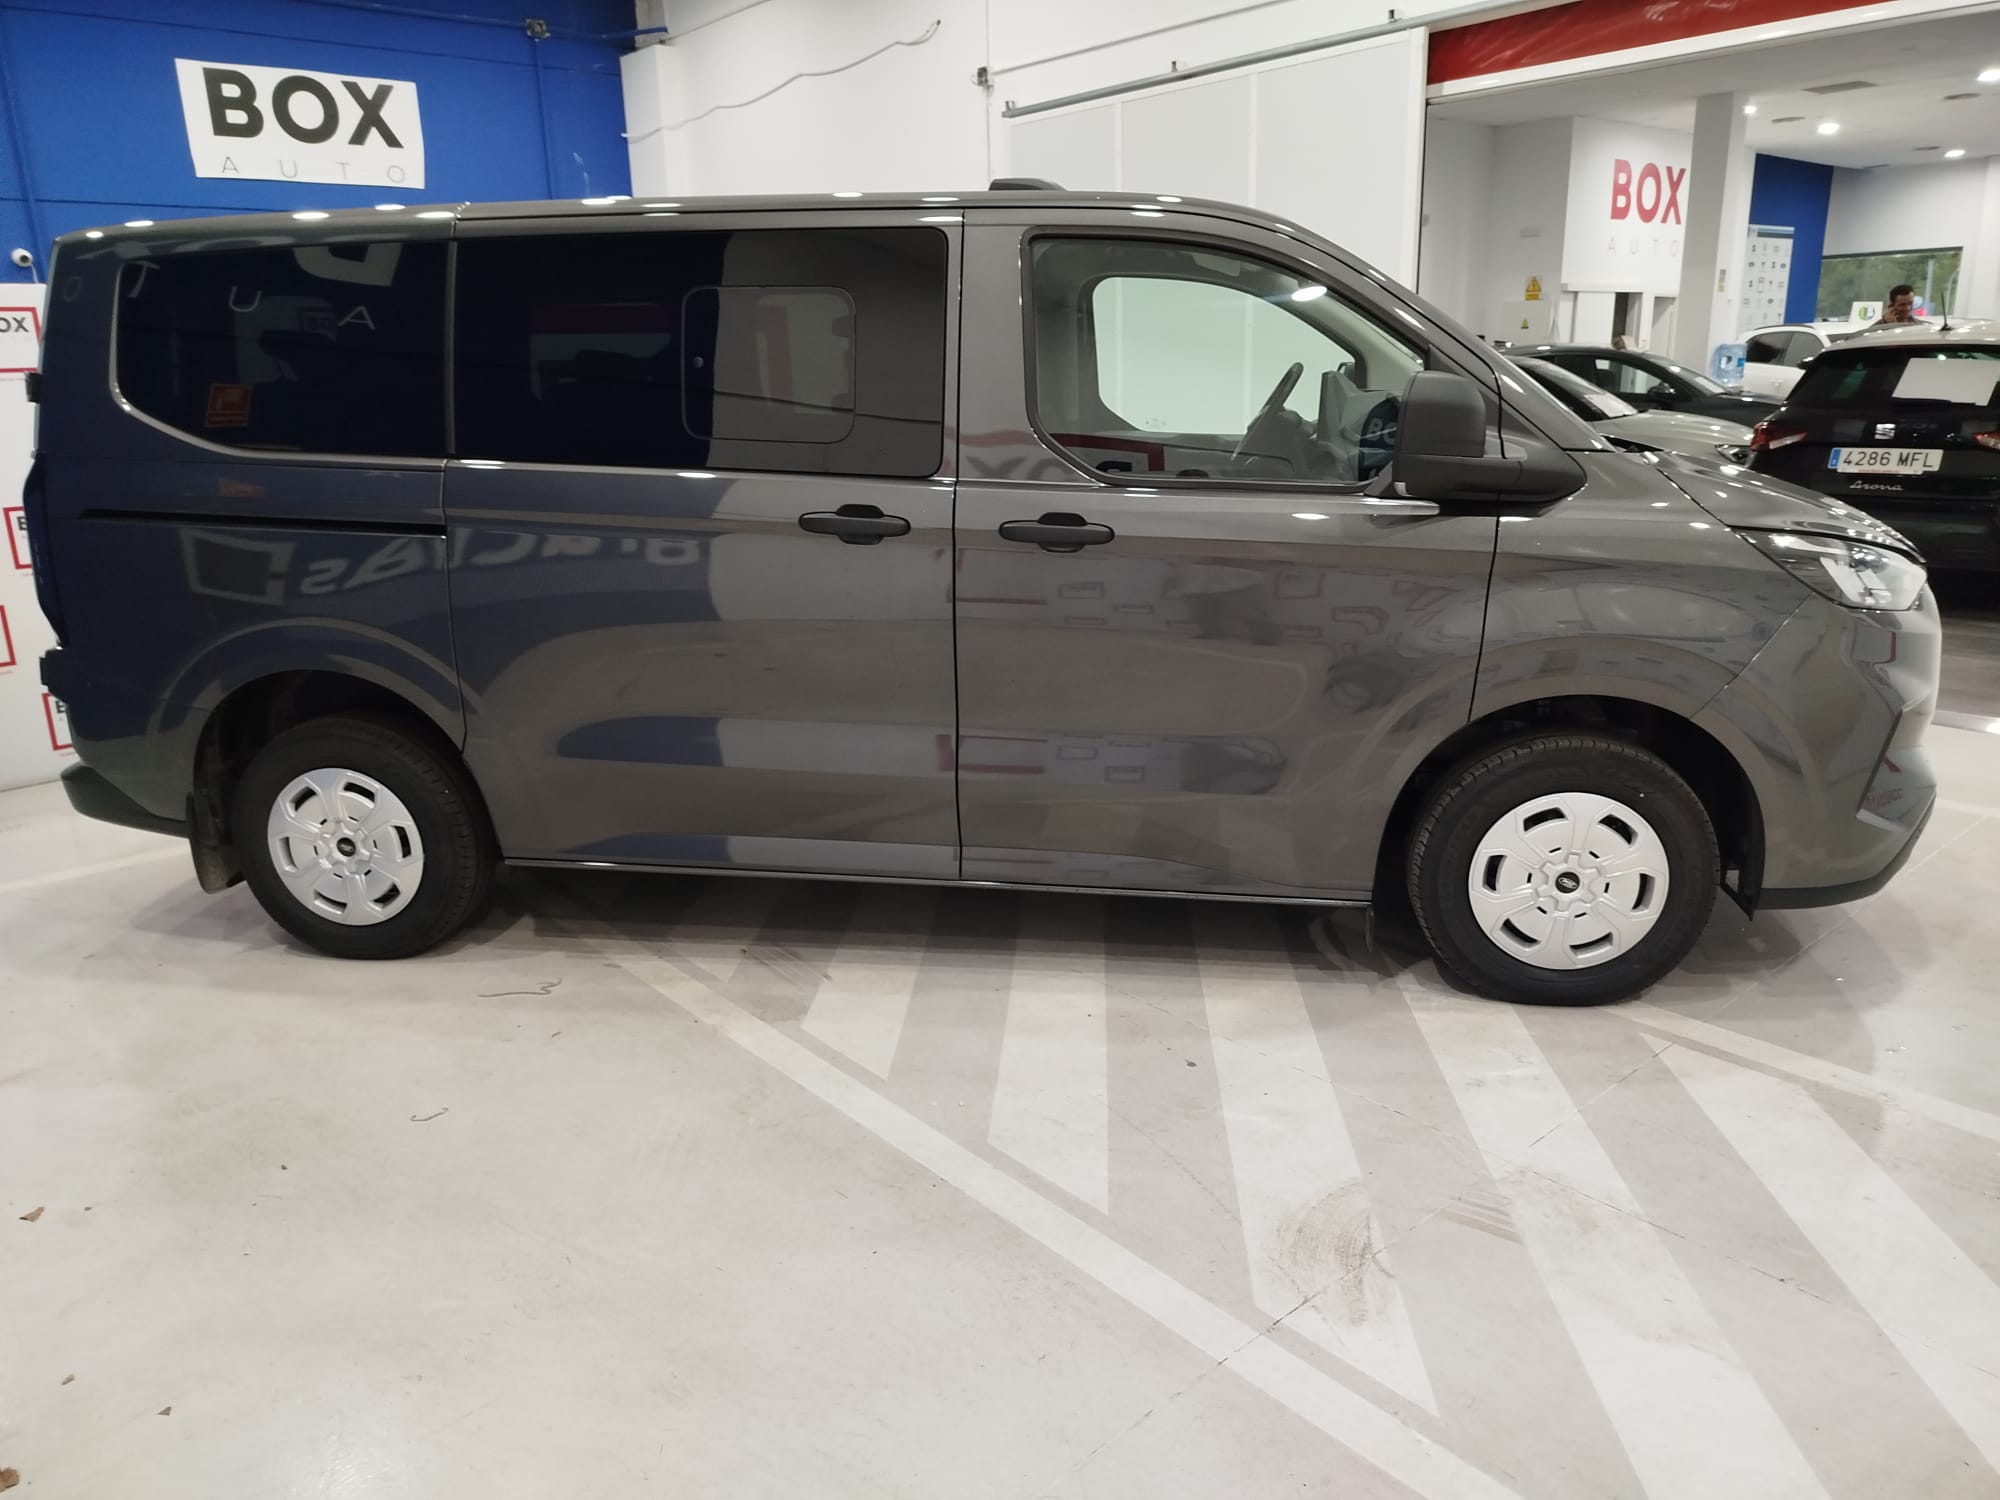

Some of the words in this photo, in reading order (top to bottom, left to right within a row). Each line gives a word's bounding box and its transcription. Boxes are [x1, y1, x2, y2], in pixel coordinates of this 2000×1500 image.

[202, 66, 405, 149] BOX
[222, 156, 405, 184] AUTO
[1610, 159, 1687, 225] BOX
[1608, 236, 1681, 257] AUTO
[1843, 451, 1891, 467] 4286
[1896, 452, 1934, 469] MFL
[1849, 480, 1904, 491] Arona
